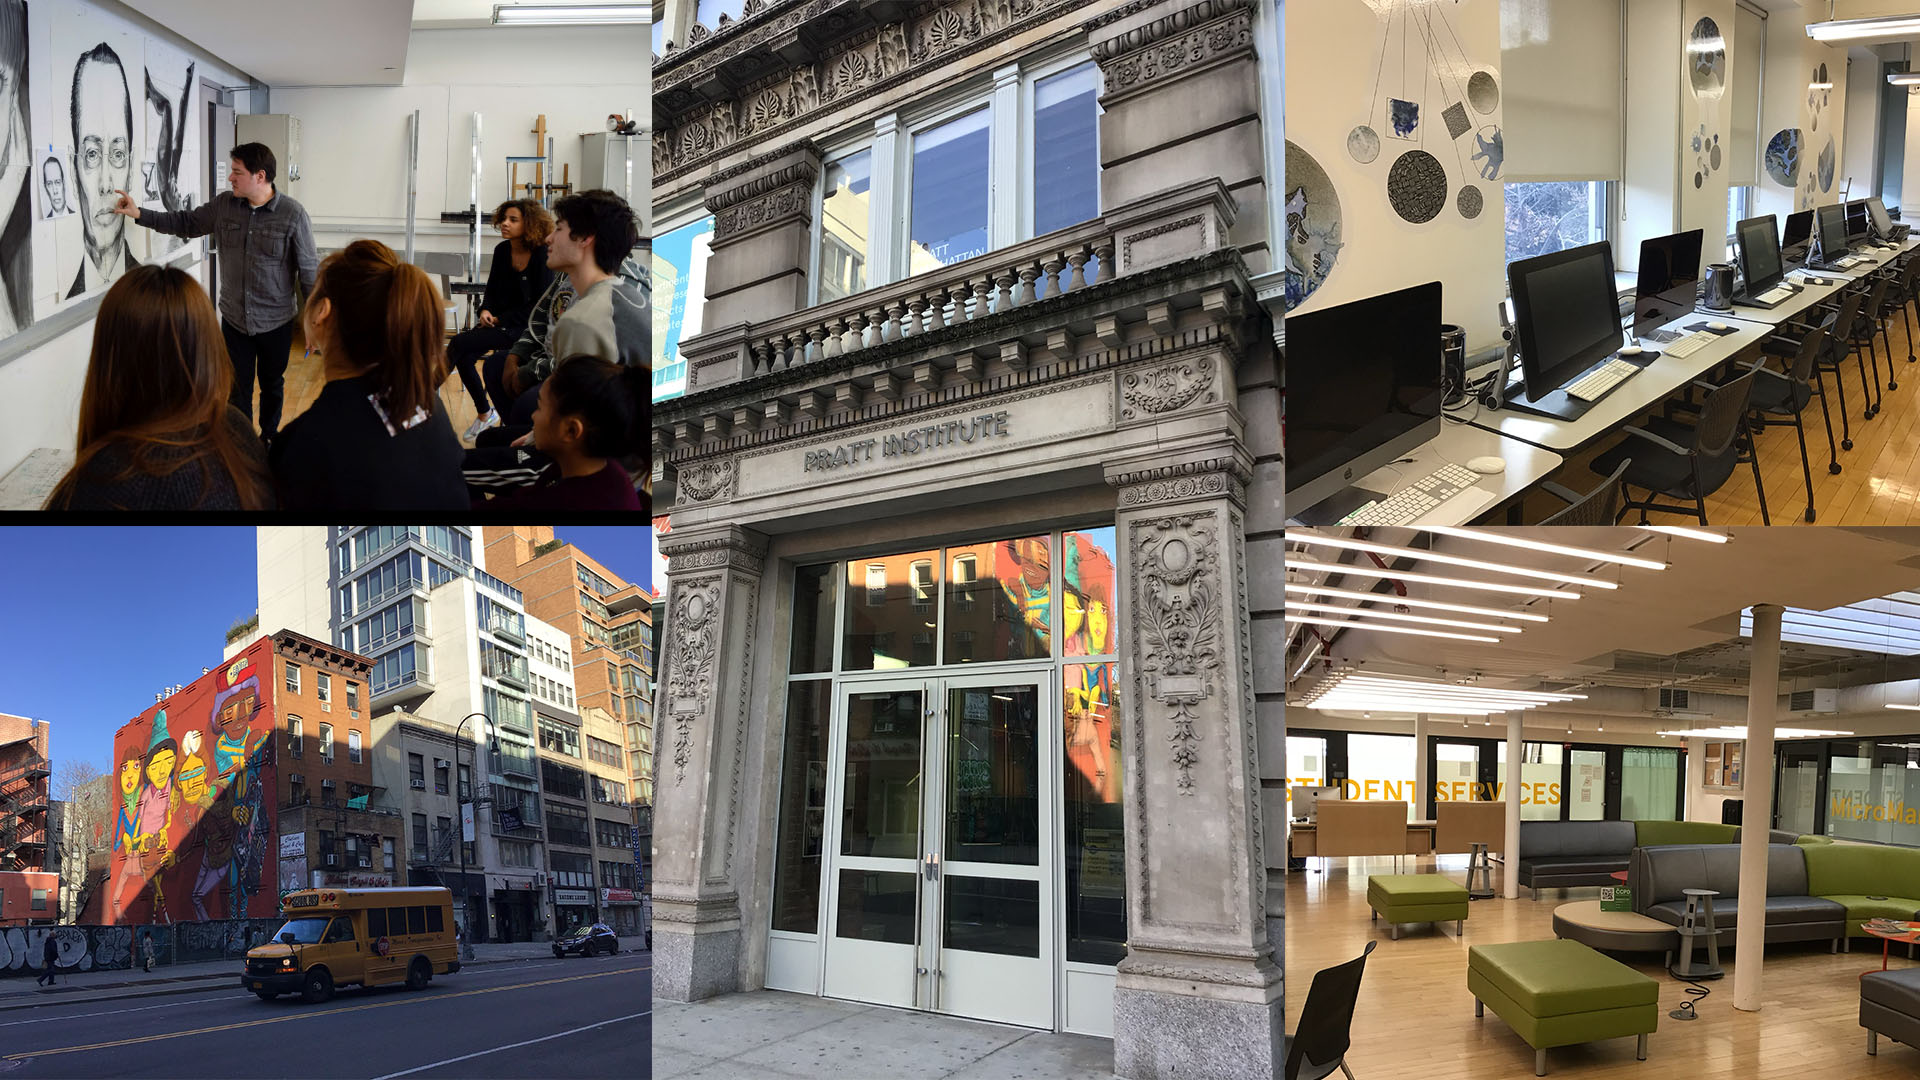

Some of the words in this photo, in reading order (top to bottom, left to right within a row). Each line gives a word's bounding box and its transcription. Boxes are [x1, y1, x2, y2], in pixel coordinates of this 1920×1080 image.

[804, 437, 876, 472] PRATT
[881, 410, 1008, 457] INSTITUTE
[1435, 781, 1560, 805] SERVCES
[1832, 797, 1920, 825] MicroMa
